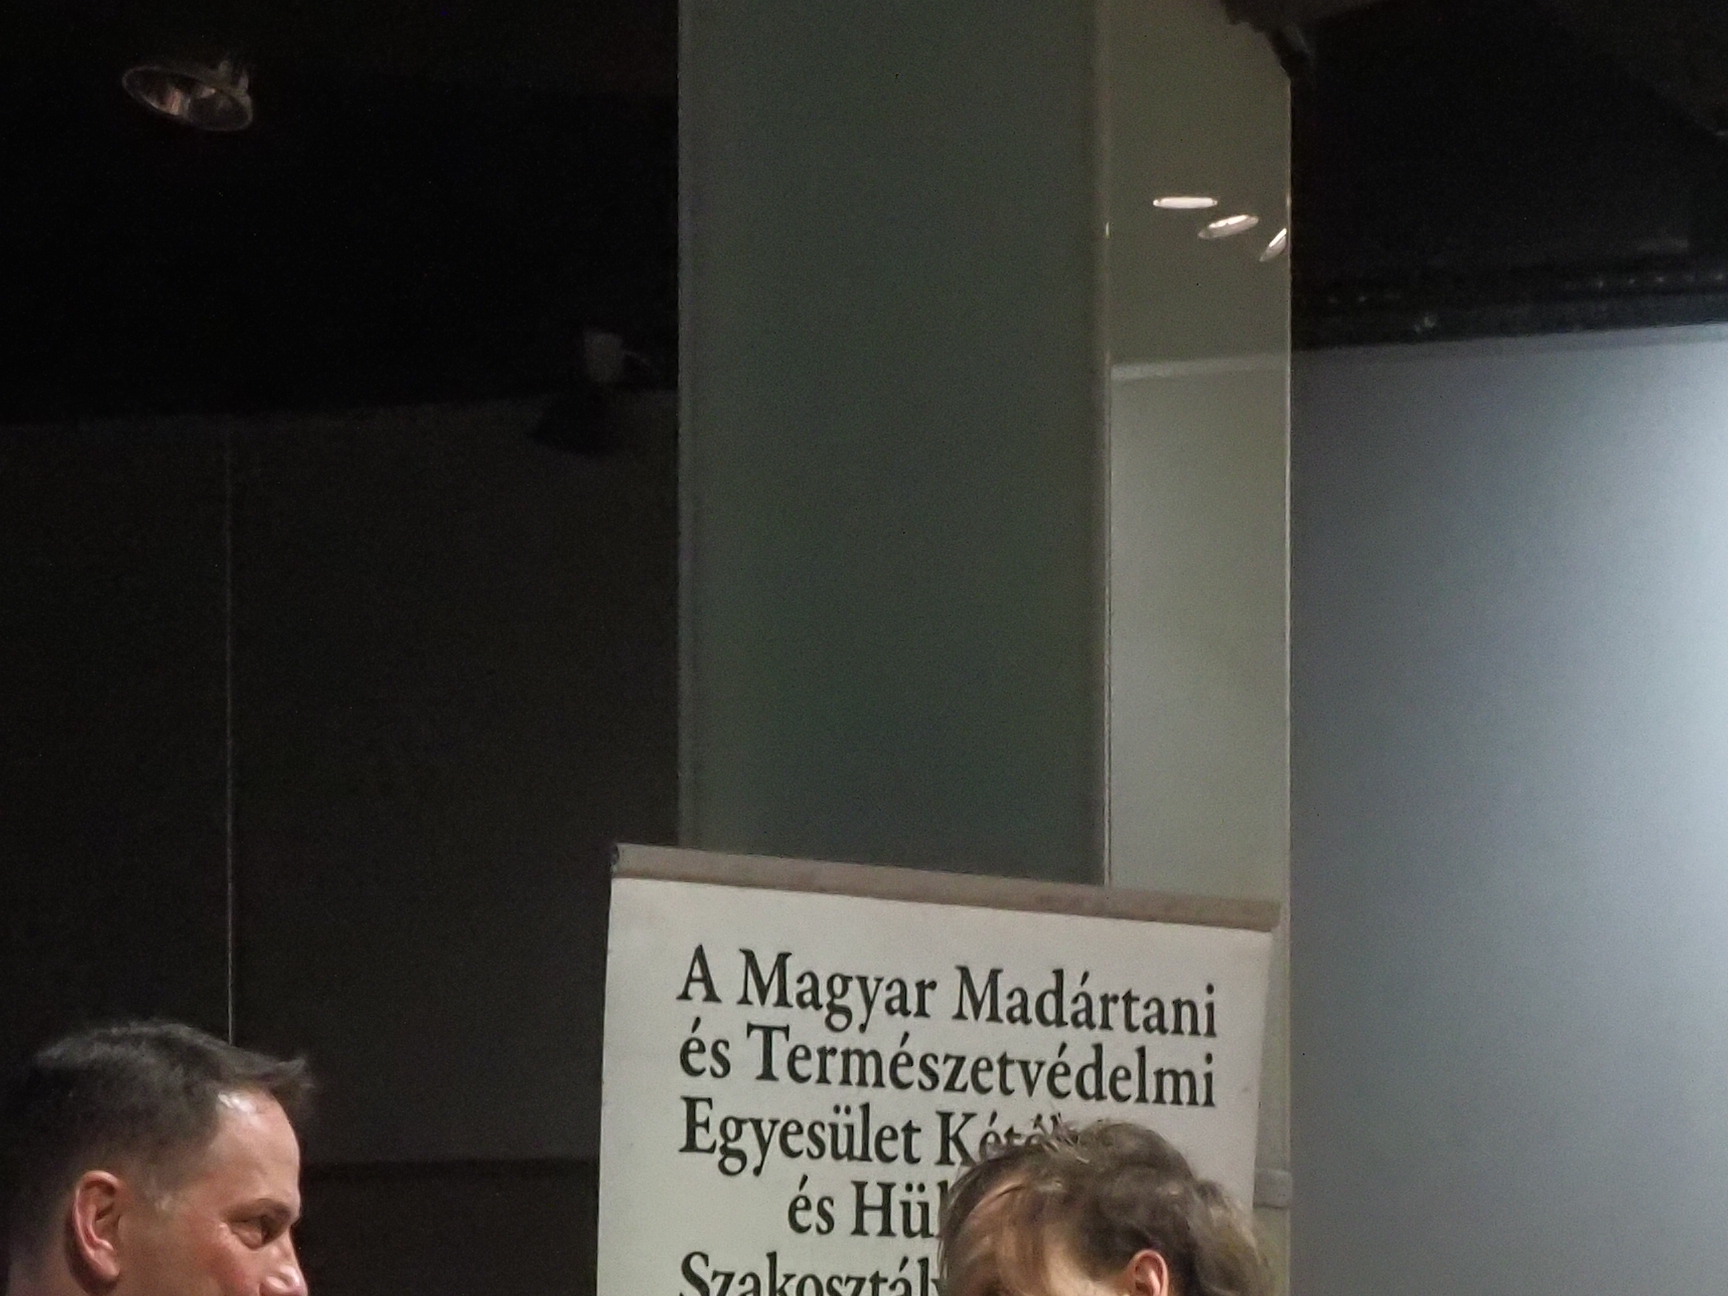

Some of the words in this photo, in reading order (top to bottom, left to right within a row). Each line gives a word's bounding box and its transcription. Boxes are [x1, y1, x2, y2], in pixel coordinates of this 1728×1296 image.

[676, 943, 722, 1004] A
[736, 947, 937, 1033] Magyar
[952, 965, 1217, 1038] Madártani
[679, 1016, 731, 1079] és
[746, 1021, 1217, 1107] Természetvédelmi
[679, 1096, 922, 1176] Egyesület
[787, 1175, 835, 1236] és
